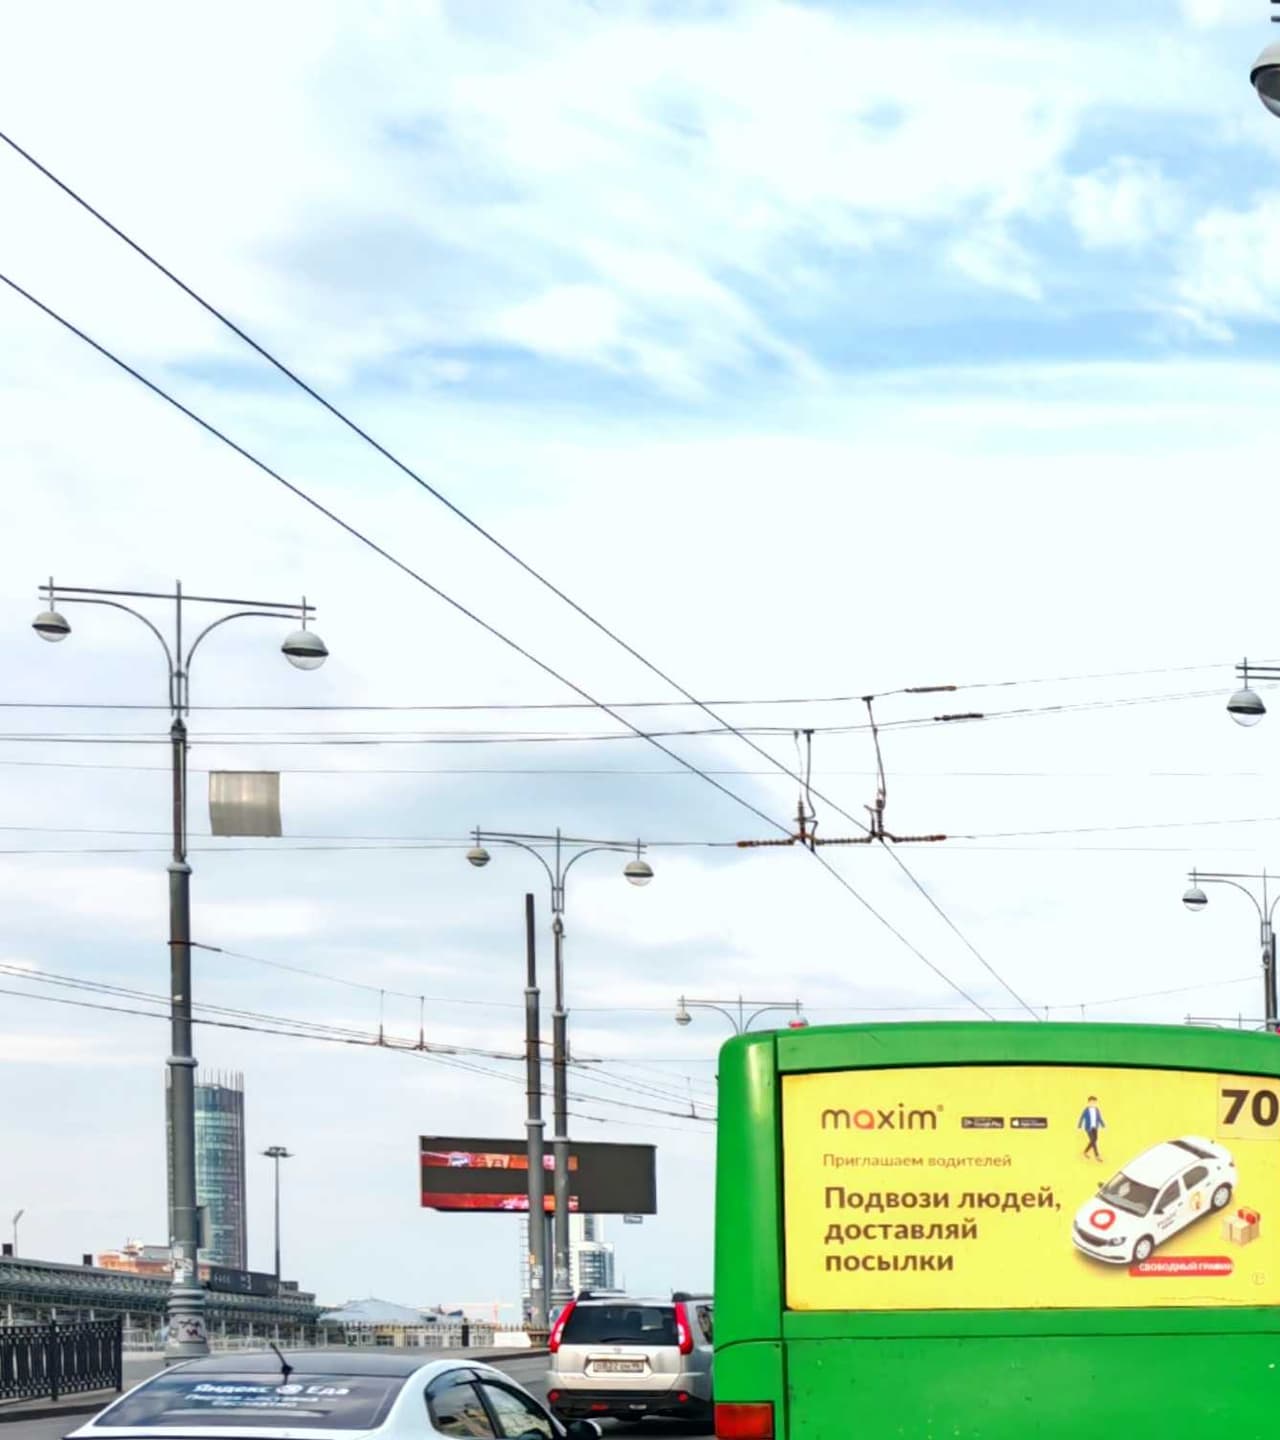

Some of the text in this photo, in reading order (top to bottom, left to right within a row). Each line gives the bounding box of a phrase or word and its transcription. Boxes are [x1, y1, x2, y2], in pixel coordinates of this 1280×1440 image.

[821, 1103, 937, 1129] maxim
[1222, 1089, 1279, 1127] 70
[822, 1153, 1012, 1168] Приглашаем водителей
[824, 1186, 1062, 1213] Подвози людей,
[824, 1217, 978, 1245] доставляй
[825, 1254, 954, 1271] посылки
[193, 1383, 350, 1395] Яндекс Еда
